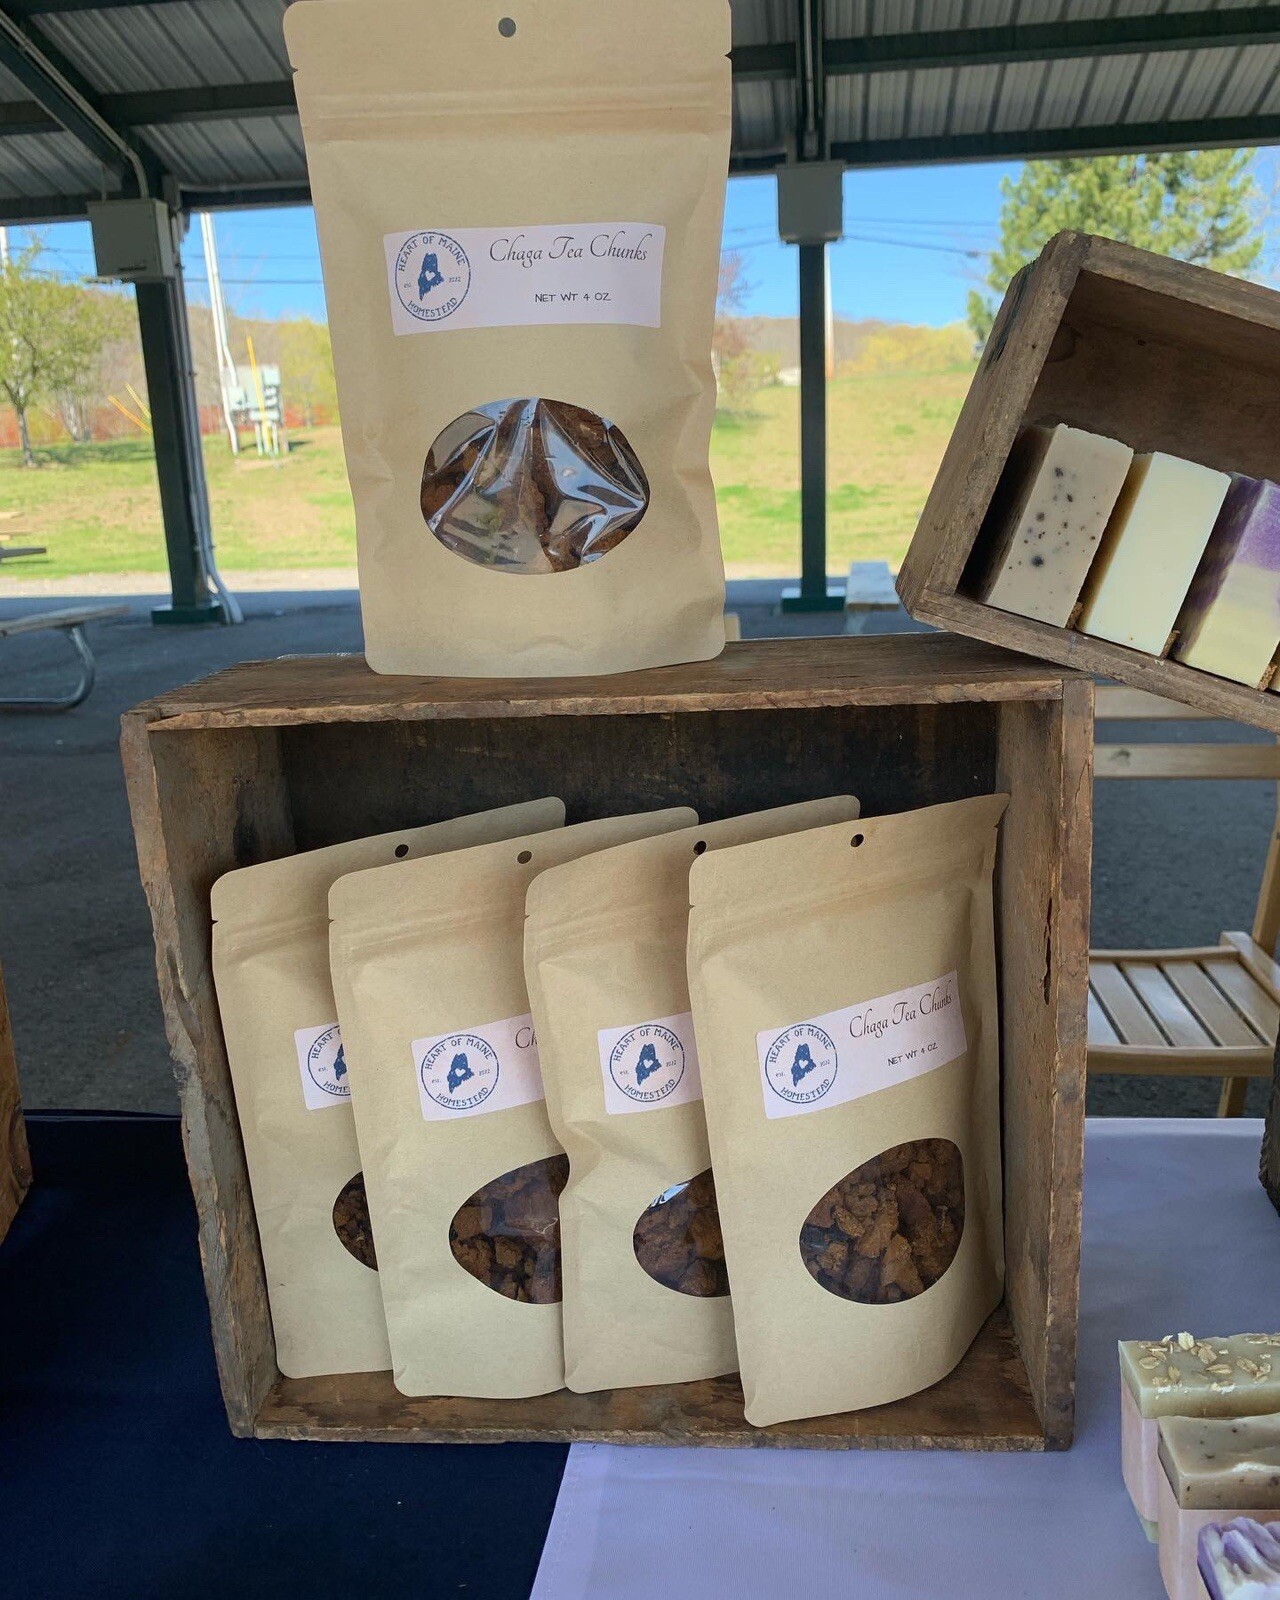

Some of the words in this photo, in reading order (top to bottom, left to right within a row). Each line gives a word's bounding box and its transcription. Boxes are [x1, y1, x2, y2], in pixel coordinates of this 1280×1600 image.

[398, 239, 418, 272] HEART
[422, 235, 435, 245] OF
[438, 237, 466, 266] MAINE
[489, 234, 543, 269] Chaga
[548, 236, 584, 260] Tea
[589, 230, 653, 262] Chunks
[407, 297, 458, 318] HOMESTEAD
[534, 293, 557, 303] NET
[560, 291, 579, 302] WT
[582, 293, 591, 301] 4
[594, 292, 612, 302] OZ
[849, 1008, 889, 1039] Chaga
[892, 1001, 917, 1025] Tea
[919, 979, 953, 1016] Chunks
[311, 1031, 333, 1060] HEART
[424, 1043, 447, 1070] HEART
[450, 1038, 462, 1047] OF
[466, 1037, 493, 1060] MAINE
[613, 1033, 637, 1062] HEART
[639, 1028, 651, 1037] OF
[653, 1028, 680, 1051] MAINE
[769, 1034, 791, 1064] HEART
[794, 1027, 805, 1037] OF
[807, 1027, 832, 1051] MAINE
[887, 1056, 903, 1067] NET
[905, 1049, 918, 1060] WT
[927, 1042, 939, 1052] OZ
[435, 1086, 490, 1108] HOMESTEAD
[624, 1078, 676, 1100] HOMESTEAD
[780, 1078, 830, 1101] HOMESTEAD
